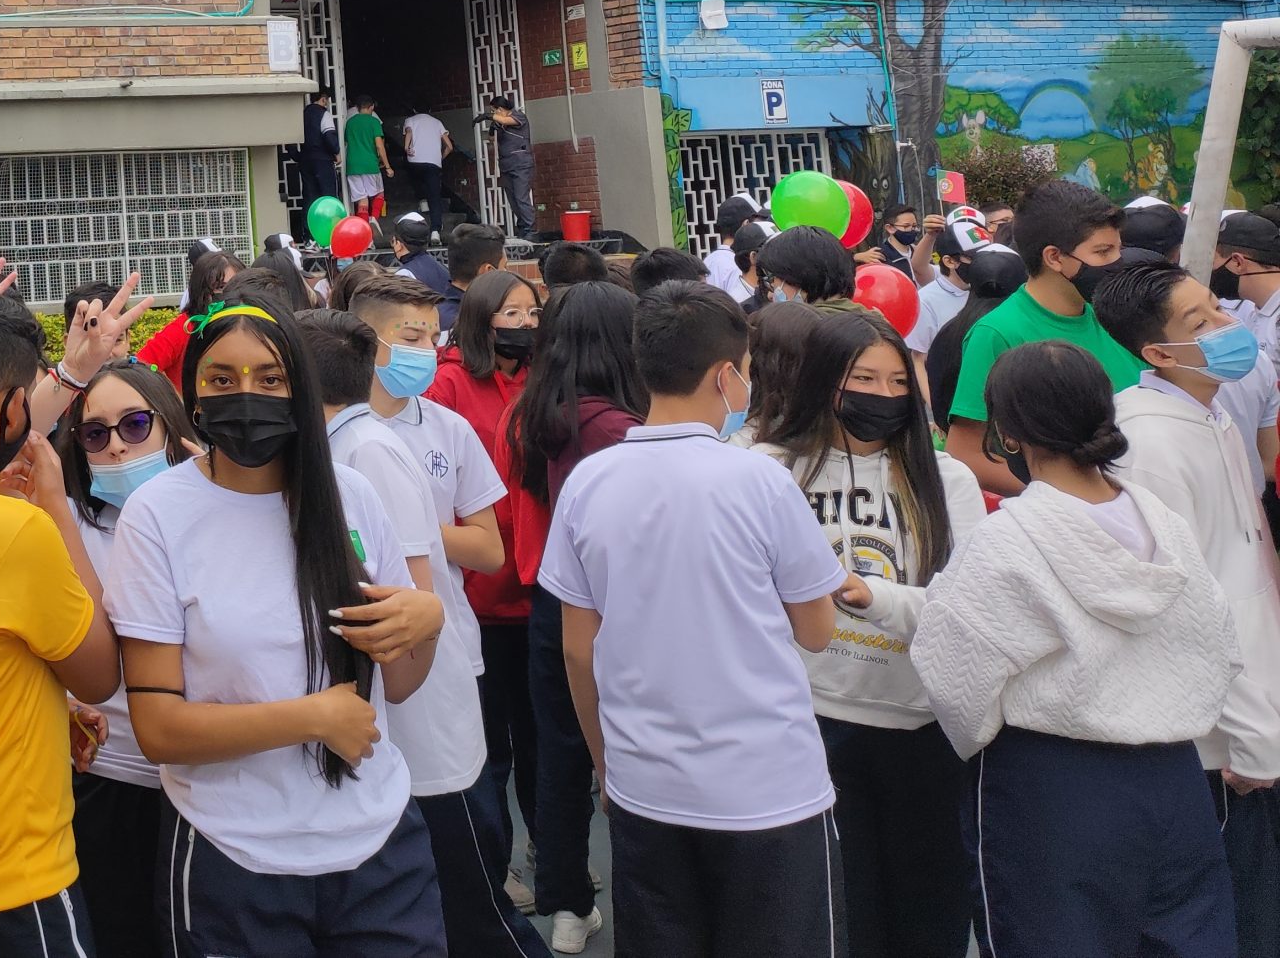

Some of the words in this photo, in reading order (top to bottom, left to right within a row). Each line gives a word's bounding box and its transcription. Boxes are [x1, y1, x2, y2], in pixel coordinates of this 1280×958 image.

[272, 34, 293, 62] B
[762, 80, 783, 89] ZONA
[766, 92, 782, 116] P
